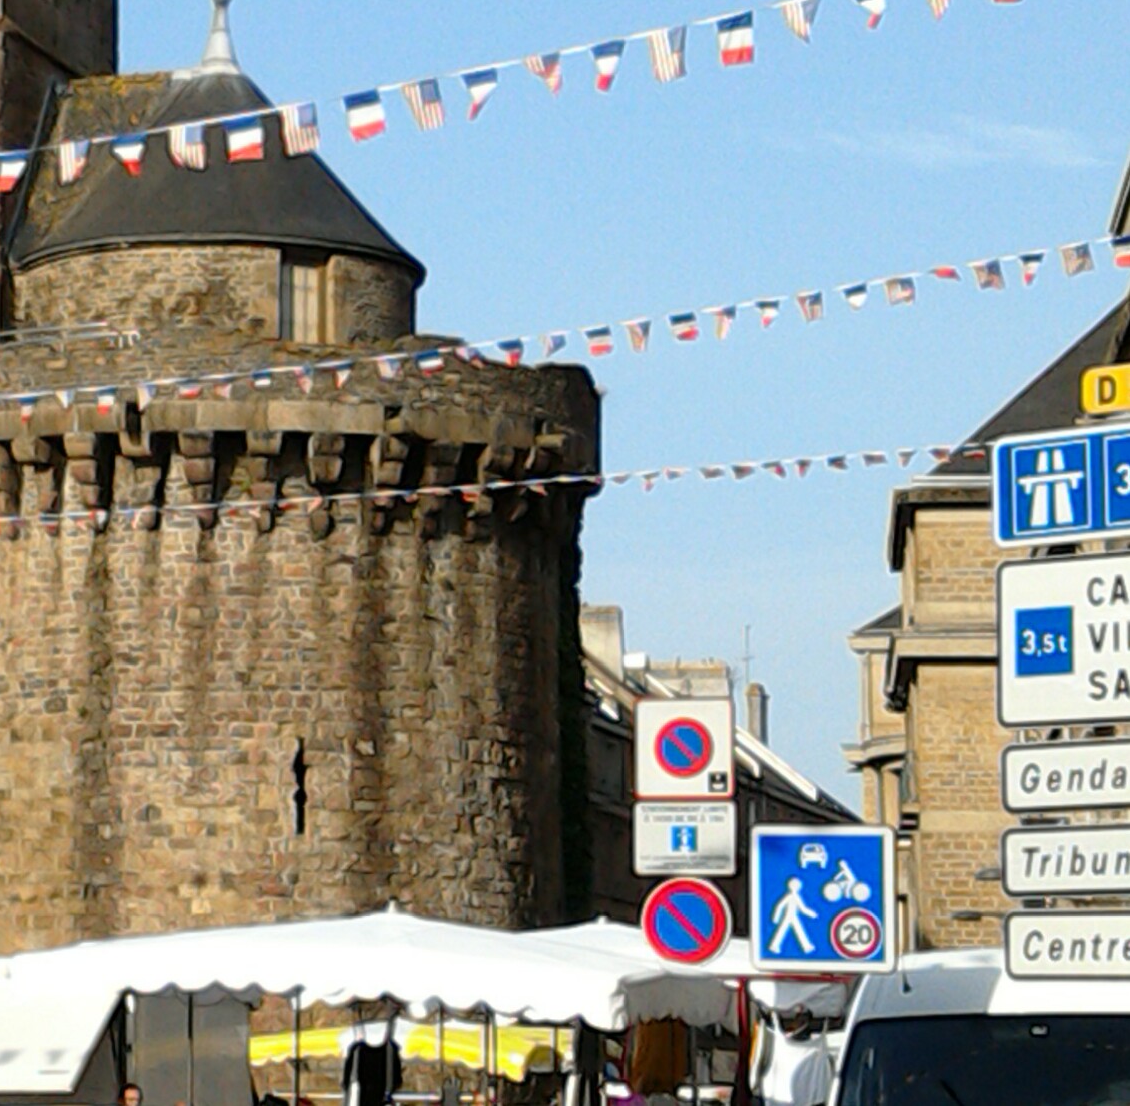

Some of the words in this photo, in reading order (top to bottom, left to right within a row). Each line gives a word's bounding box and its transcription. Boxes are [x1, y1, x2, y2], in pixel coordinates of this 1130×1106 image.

[1099, 375, 1117, 405] D
[1087, 574, 1129, 607] CA
[1087, 620, 1130, 653] VI
[1088, 667, 1130, 701] SA
[1020, 758, 1127, 794] Genda
[1022, 845, 1130, 877] Tribun
[843, 924, 872, 945] 20
